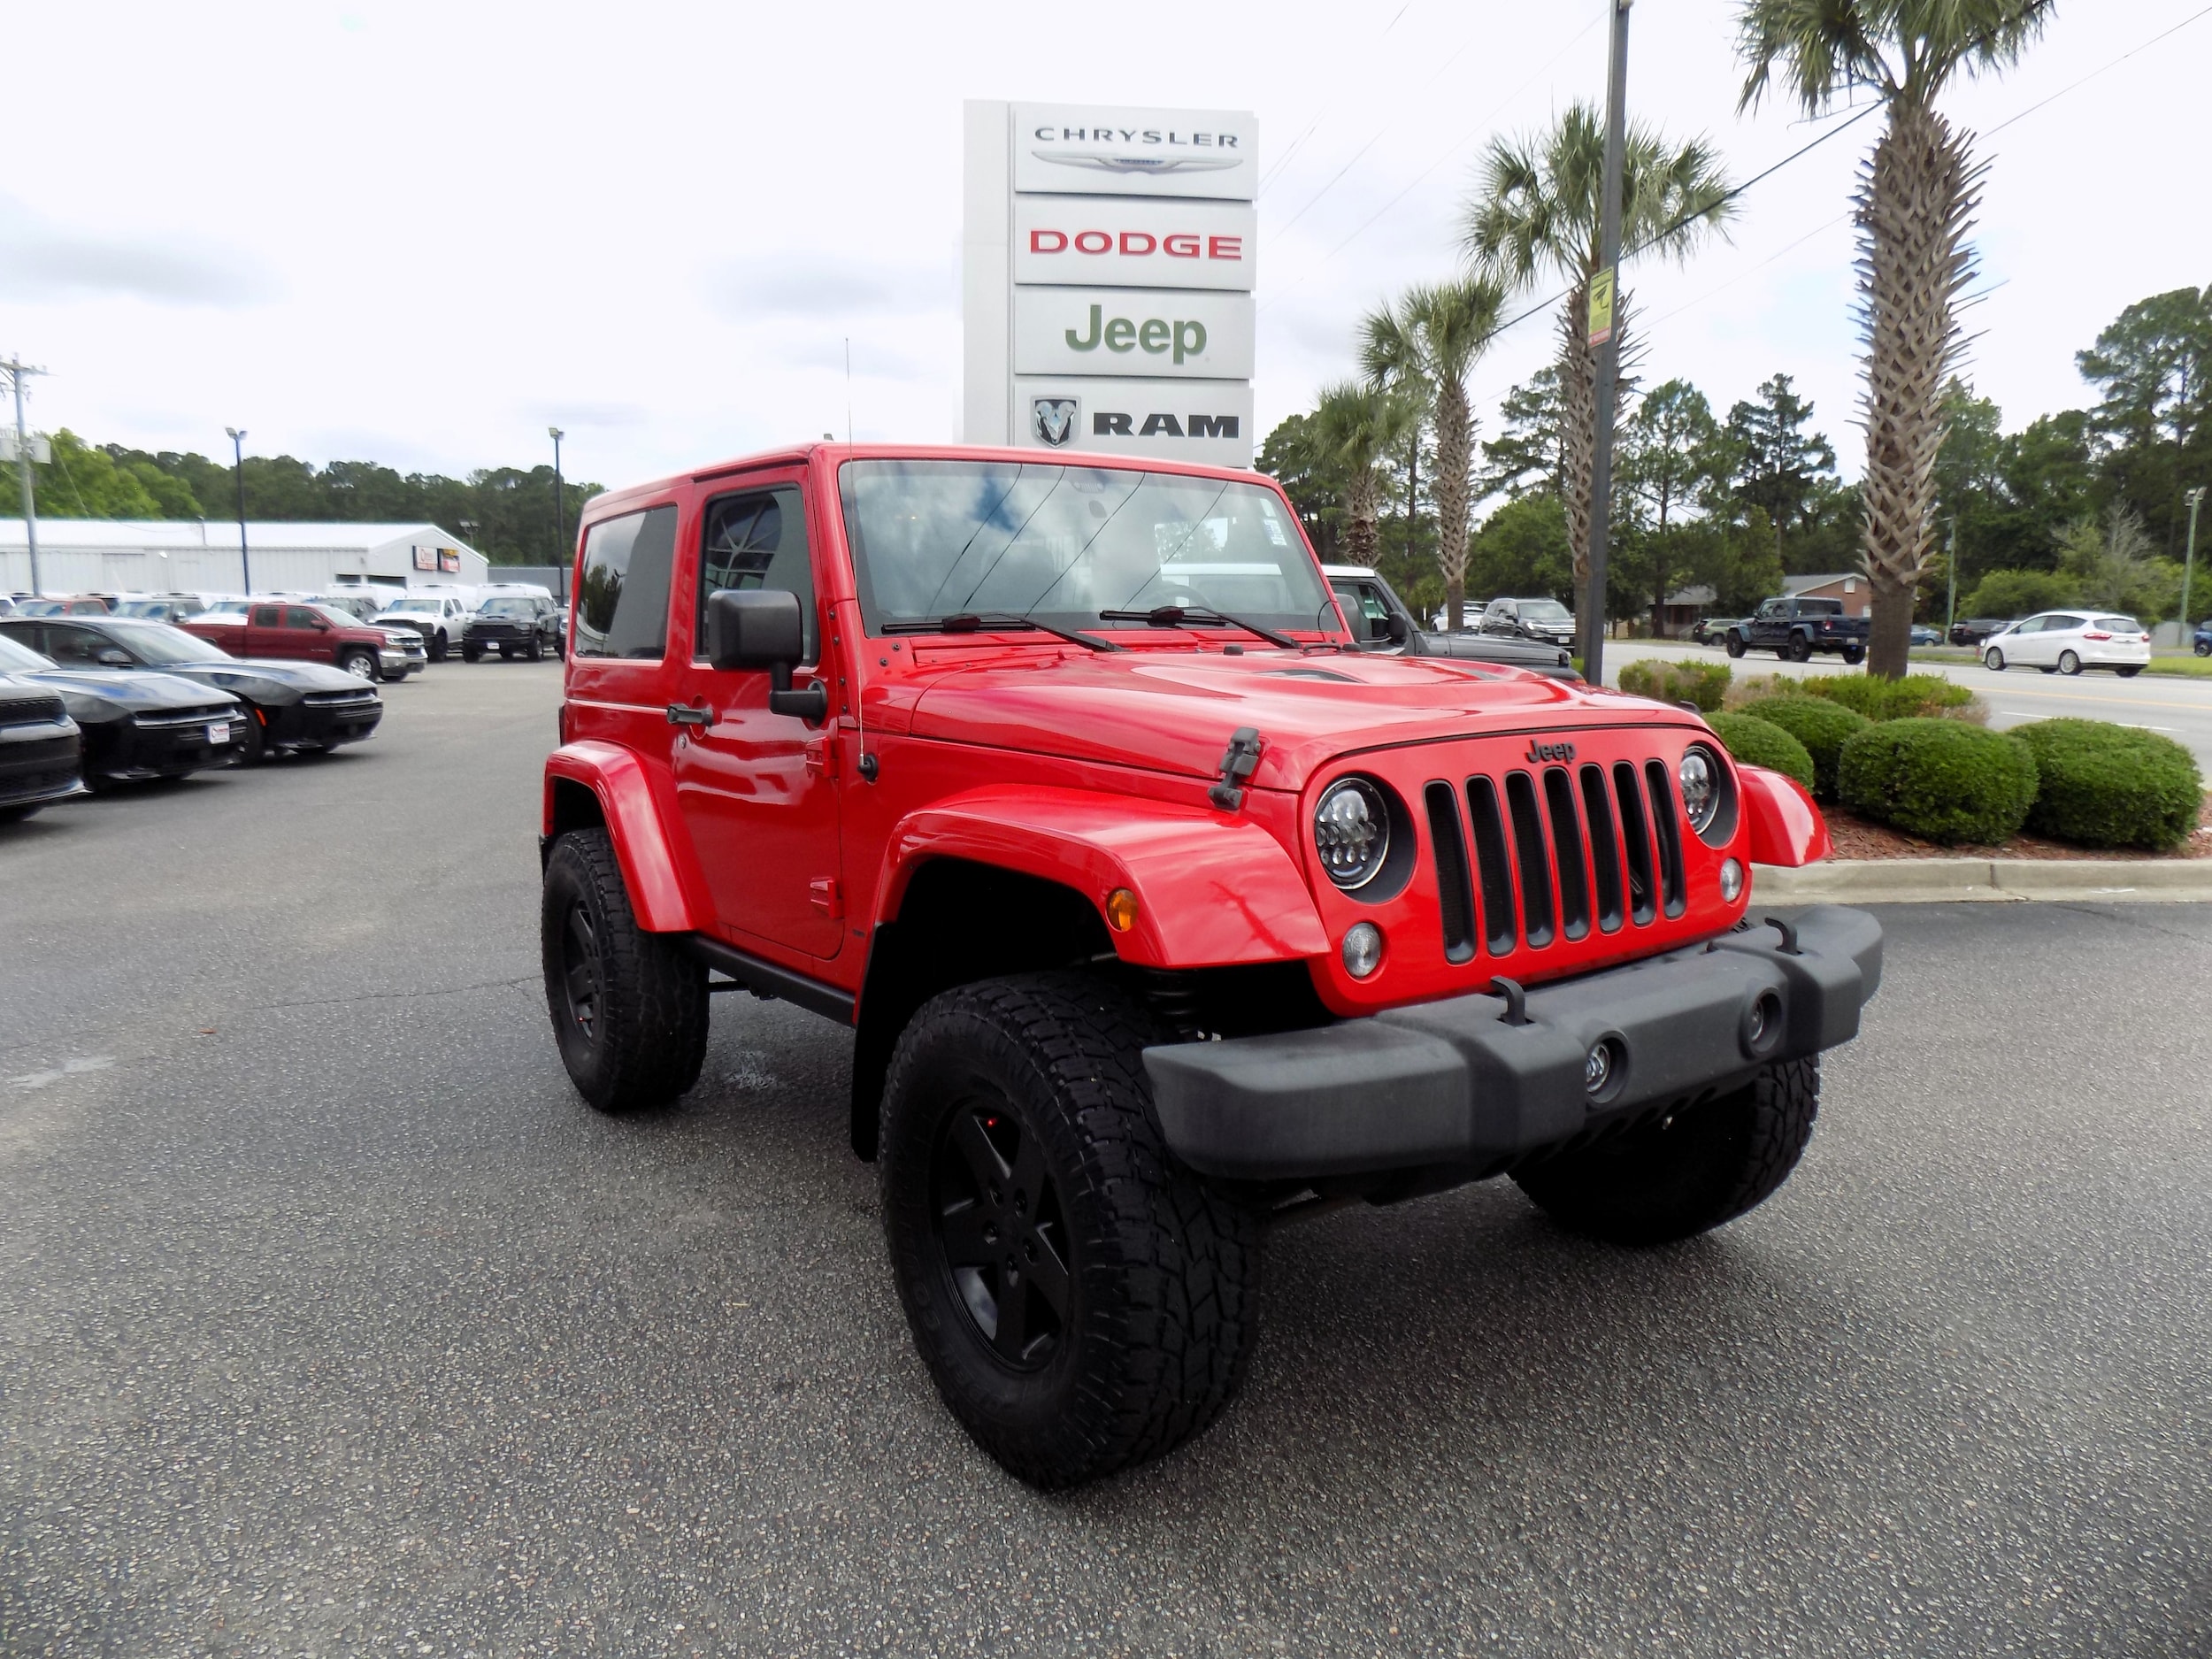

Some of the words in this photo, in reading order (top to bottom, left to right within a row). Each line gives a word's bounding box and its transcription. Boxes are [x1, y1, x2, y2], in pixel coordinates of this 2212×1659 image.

[1034, 127, 1239, 148] CHRYSLER
[1030, 230, 1242, 261] DODGE
[1065, 304, 1207, 365] Jeep
[1093, 412, 1239, 439] RAM
[1525, 738, 1576, 764] Jeep
